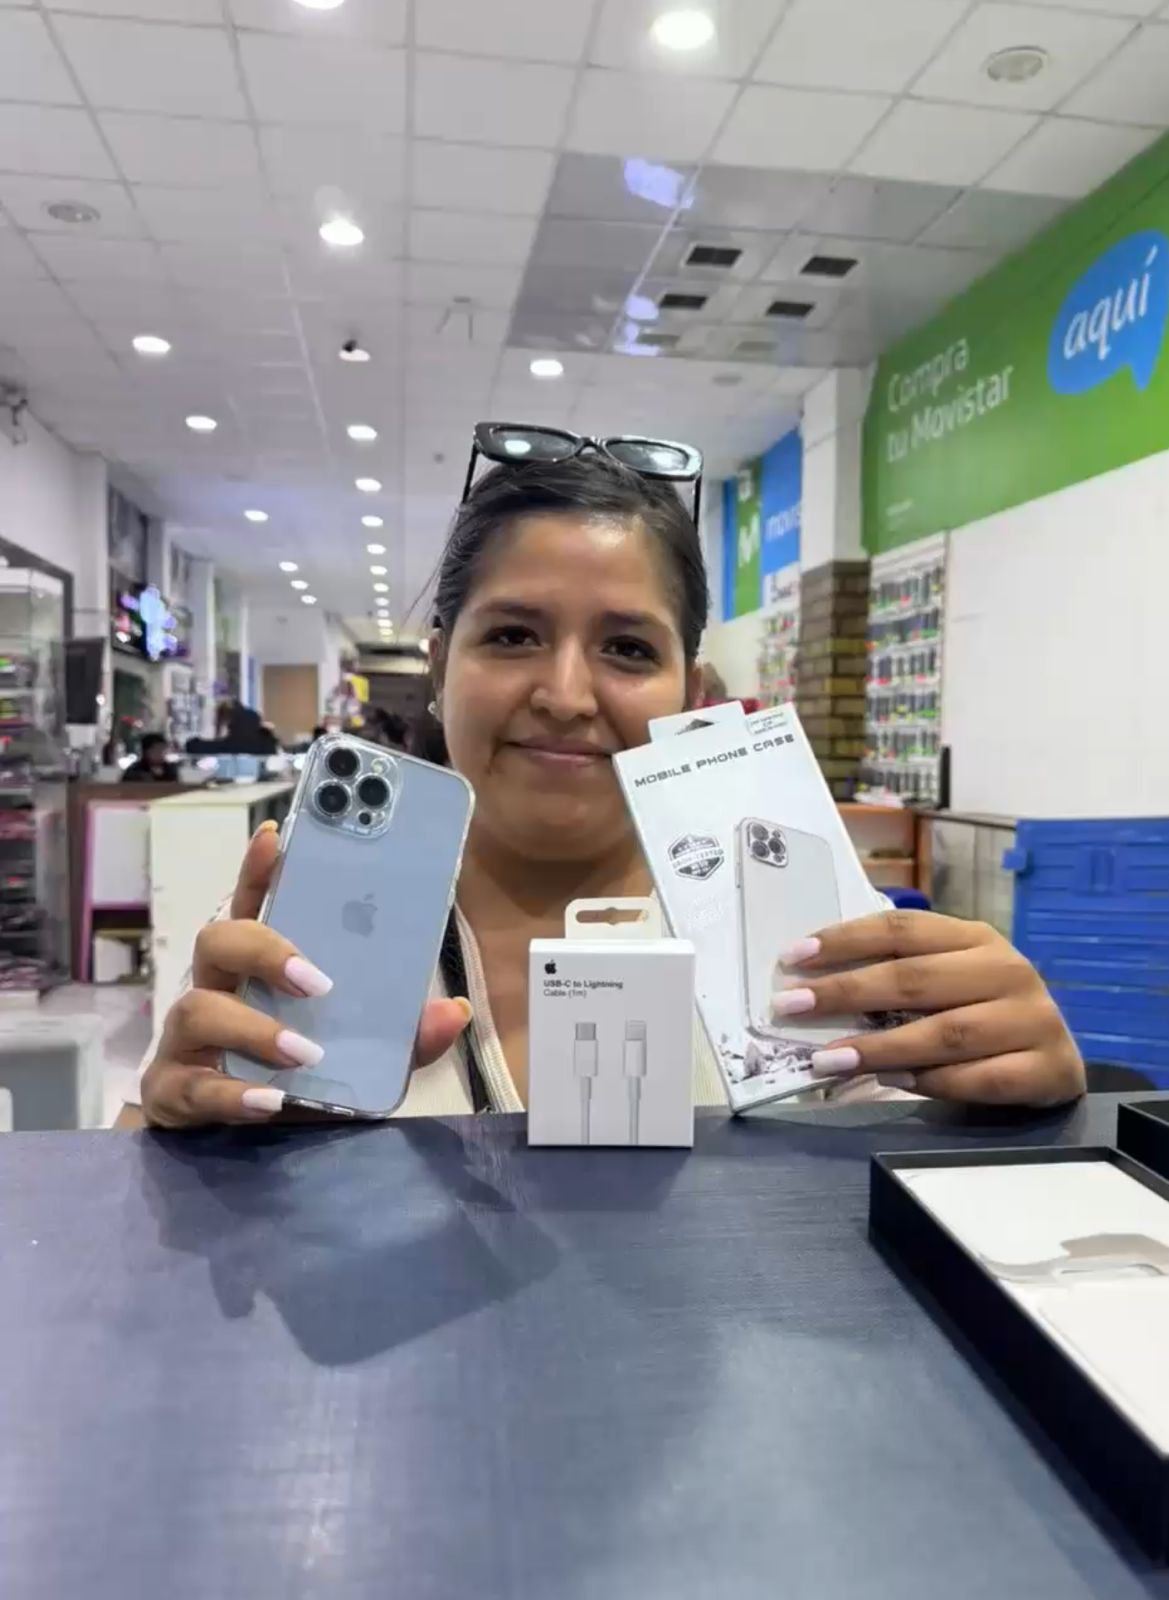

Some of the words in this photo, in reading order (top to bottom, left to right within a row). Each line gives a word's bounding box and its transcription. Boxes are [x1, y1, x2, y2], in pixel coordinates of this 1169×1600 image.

[1064, 244, 1158, 361] aquí
[888, 337, 970, 414] Compra
[887, 431, 909, 463] tu
[911, 364, 1014, 449] Movistar
[634, 763, 692, 788] MOBILE
[696, 747, 748, 769] PHONE
[753, 733, 795, 752] CASE
[543, 979, 571, 988] USB-C
[573, 980, 582, 988] to
[583, 979, 624, 990] Lightning
[543, 988, 567, 997] Cable
[568, 989, 587, 999] (1m)
